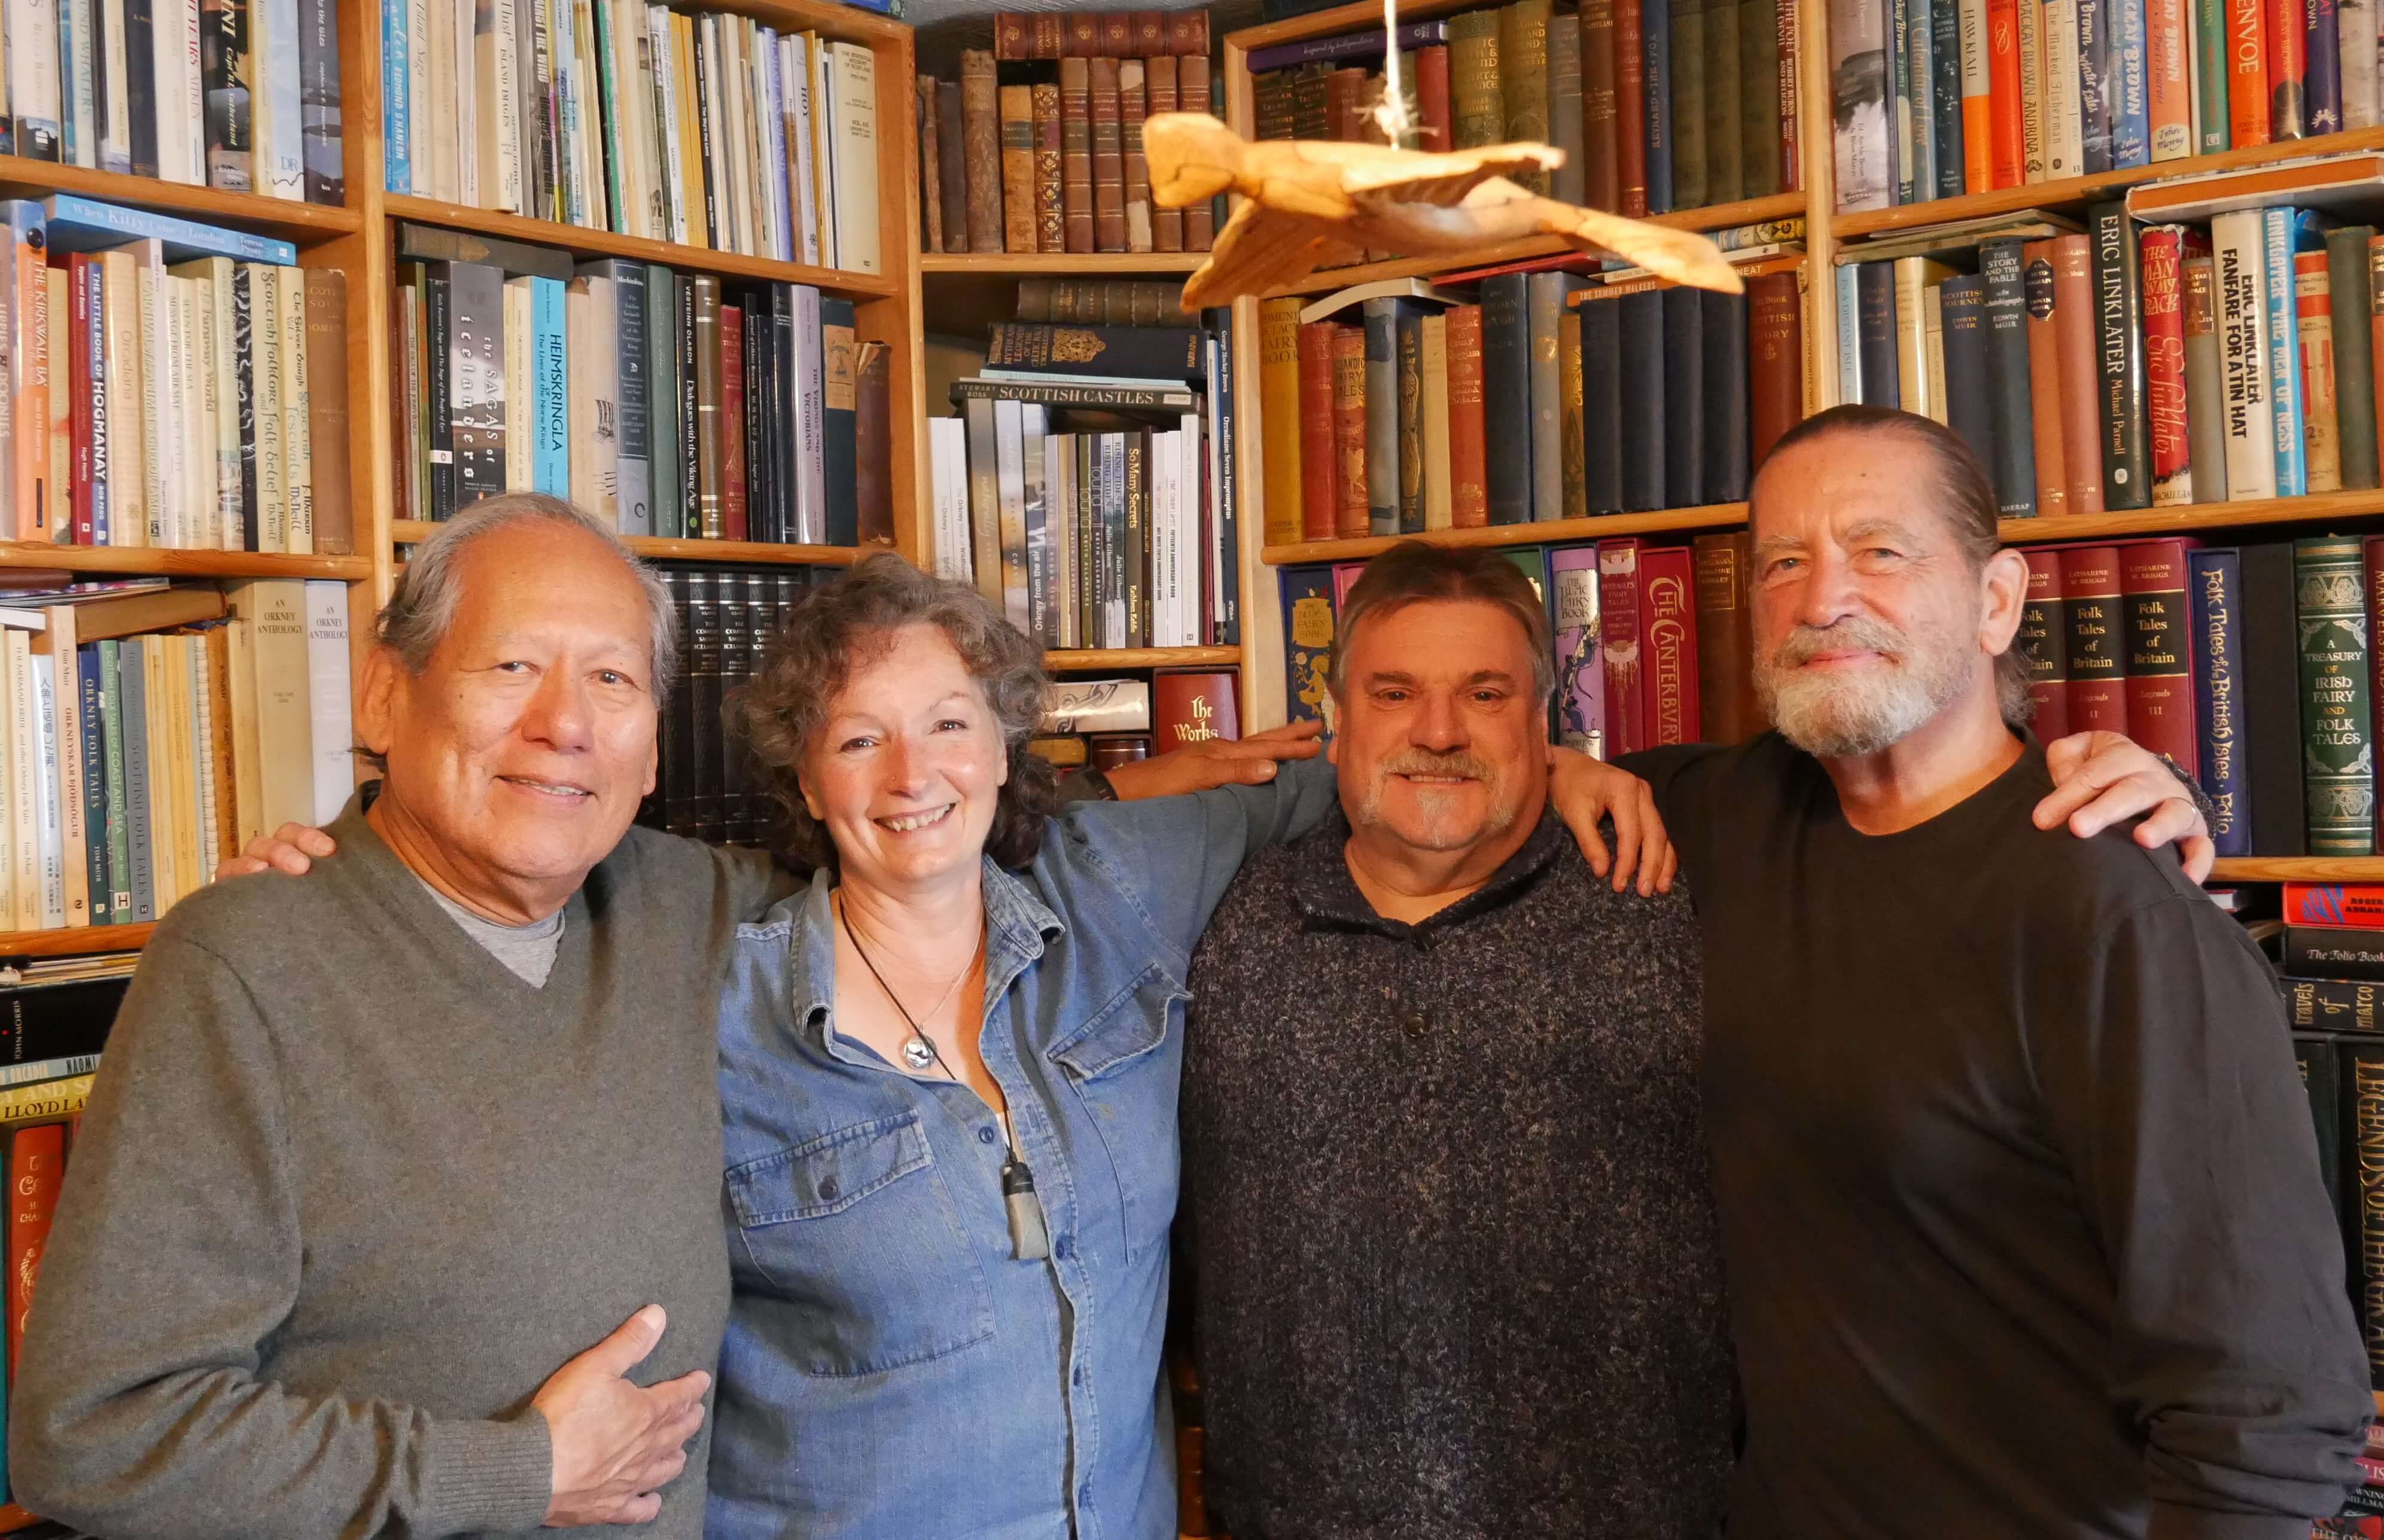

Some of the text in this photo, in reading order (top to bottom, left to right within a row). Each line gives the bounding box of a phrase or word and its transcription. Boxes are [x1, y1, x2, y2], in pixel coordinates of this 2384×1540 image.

[416, 2, 426, 42] Island
[188, 18, 199, 65] YEARS
[536, 32, 549, 83] THE WIND
[1964, 10, 1977, 80] HAWKFALL
[2078, 2, 2099, 112] Brown winter tales
[2164, 26, 2179, 81] BROWN
[80, 41, 92, 115] WHALERS
[415, 48, 425, 78] Saga
[1911, 13, 1931, 147] A Calendar of Love
[2048, 6, 2062, 144] The Masked Fisherman
[1786, 58, 1795, 115] ROBERT BURNS
[2124, 47, 2140, 115] BROWN
[394, 67, 405, 160] REDMOND O'HANLON
[2023, 50, 2038, 154] BROWN ANDRINA
[35, 260, 47, 288] THE
[1987, 258, 2017, 267] STORY
[293, 292, 302, 312] The
[1579, 281, 1656, 300] THE SUMMER WALKERS
[2100, 215, 2125, 375] ERIC LINKLATER
[35, 291, 47, 362] KIRKWALL
[93, 295, 102, 329] LITTLE
[94, 332, 103, 361] BOOK
[260, 272, 279, 406] Scottish Folklore
[2222, 248, 2247, 438] FANFARE FOR A TIN HAT
[2242, 275, 2263, 404] ERIC LINKLATER
[2267, 211, 2294, 452] LINKLATER THE MEN OF NESS
[95, 364, 103, 377] OF
[121, 330, 133, 400] Orcadiana
[201, 309, 215, 412] Faraway World
[296, 353, 305, 386] Bough
[2146, 335, 2185, 373] Eric
[36, 366, 48, 387] BA'
[539, 372, 546, 380] of
[550, 334, 563, 451] HEIMSKRINGLA
[260, 393, 269, 410] and
[685, 379, 695, 421] Dialogues
[1000, 388, 1153, 404] SCOTTISH CASTLES
[92, 381, 106, 480] HOGMANAY
[2111, 379, 2126, 455] Michael Parnell
[261, 413, 281, 497] Folk-Belief
[686, 459, 697, 489] Viking
[1128, 448, 1139, 529] So Many Secrets
[290, 486, 302, 531] McNeill
[687, 490, 697, 509] Age
[1649, 574, 1686, 617] THE
[2202, 569, 2224, 606] Folk
[264, 612, 296, 621] ORKNEY
[316, 618, 343, 627] ORKNEY
[1561, 608, 1589, 618] BOOK
[2077, 607, 2103, 619] Folk
[2136, 619, 2167, 630] Tales
[2138, 602, 2164, 614] Folk
[257, 626, 303, 634] ANTHOLOGY
[2076, 624, 2105, 635] Tales
[2085, 640, 2098, 652] of
[2146, 635, 2160, 648] of
[2209, 609, 2228, 654] Tales
[2327, 639, 2336, 649] A
[2073, 656, 2113, 668] Britain
[2134, 652, 2175, 664] Britain
[2305, 651, 2362, 663] TREASURY
[2325, 664, 2339, 673] OF
[1191, 696, 1213, 721] The
[2209, 676, 2233, 738] British
[2313, 690, 2355, 703] FAIRY
[2323, 706, 2345, 715] AND
[105, 649, 124, 834] SCOTTISH FOLK TALES OF COAST AND SEA
[1173, 721, 1218, 741] Works
[2313, 733, 2361, 745] TALES
[2316, 718, 2355, 731] FOLK
[84, 678, 100, 808] ORKNEY FOLK TALES
[2209, 740, 2232, 780] Isles
[2212, 792, 2233, 834] Folio
[135, 816, 145, 850] FOLK
[94, 864, 102, 882] MUIR
[136, 856, 147, 895] TALES
[2318, 996, 2349, 1015] of
[13, 1000, 23, 1060] JOHN MORRIS
[25, 1083, 67, 1102] AND
[4, 1101, 60, 1119] LLOYD
